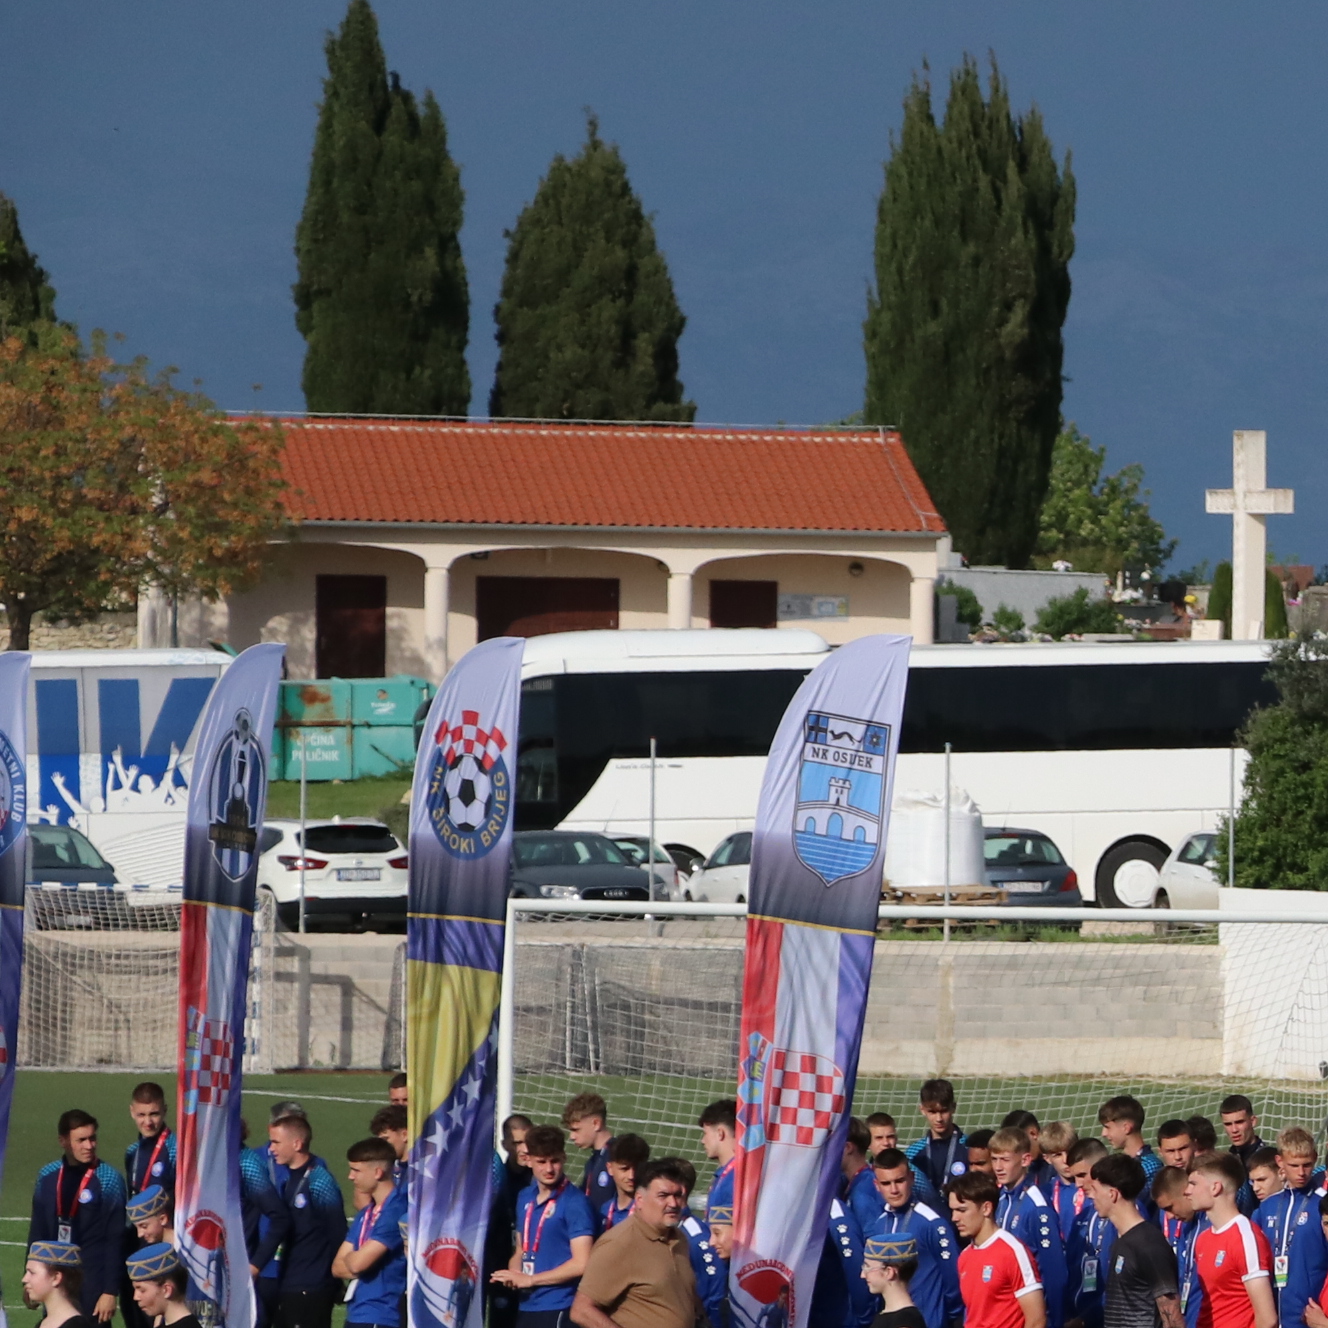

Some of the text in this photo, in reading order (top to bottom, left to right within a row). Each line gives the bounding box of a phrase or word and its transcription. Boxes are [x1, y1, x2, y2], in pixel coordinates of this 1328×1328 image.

[811, 746, 874, 769] NK OSIJEK
[10, 783, 25, 823] KLUB
[432, 806, 475, 853] ŠIROKI
[480, 771, 507, 848] BRIJEG
